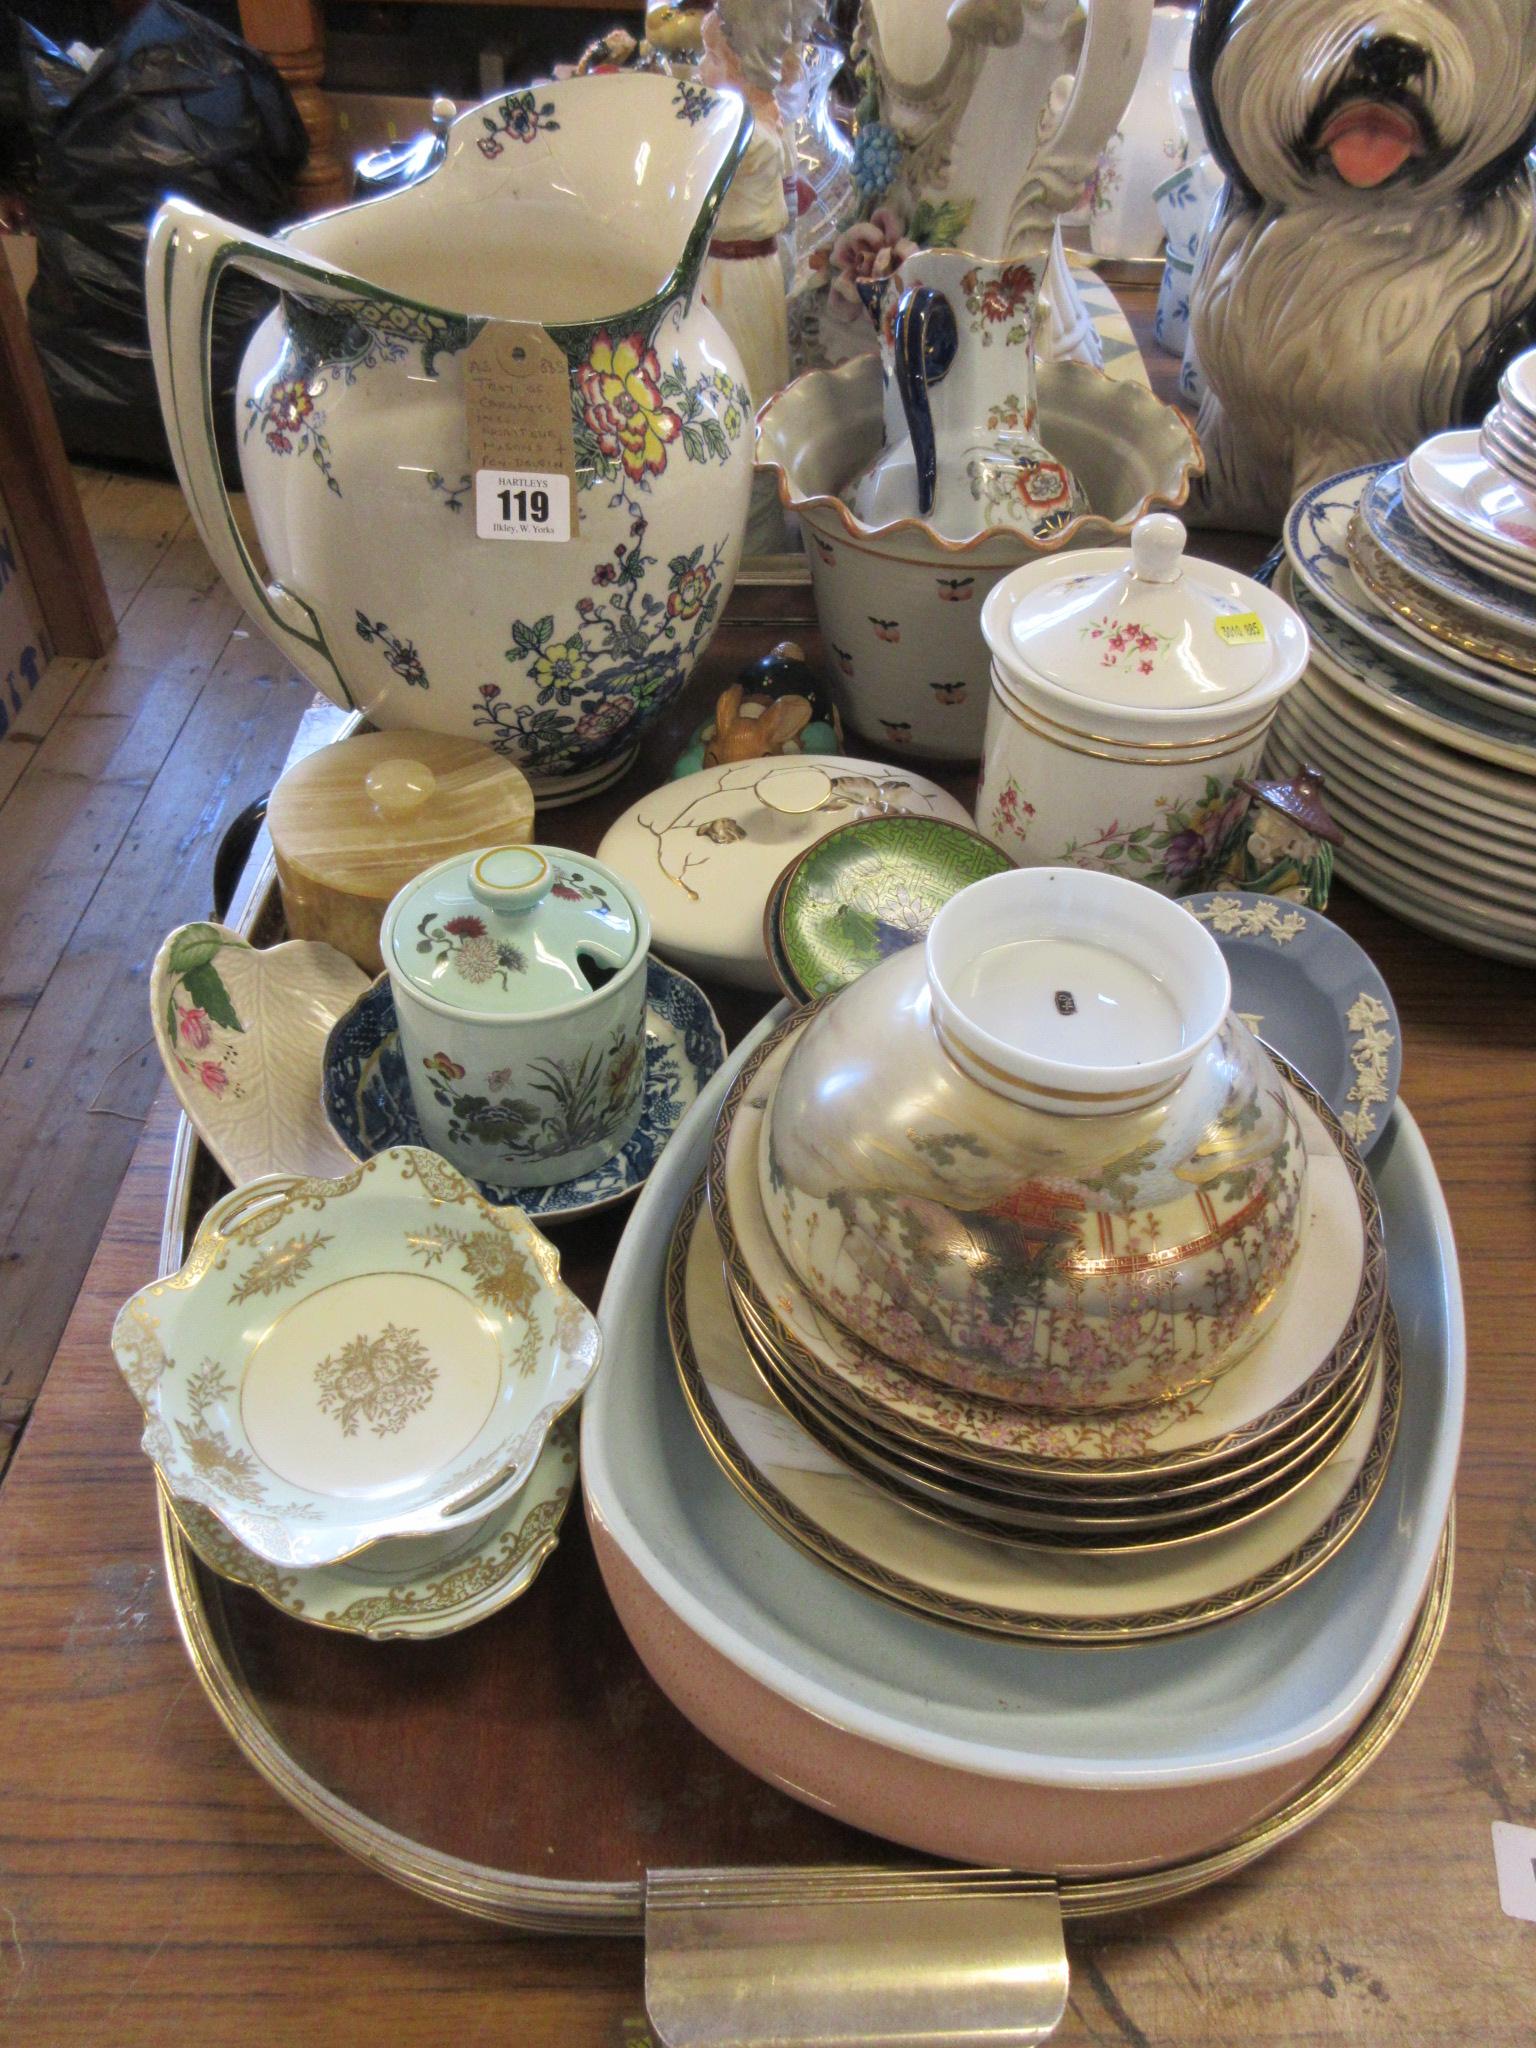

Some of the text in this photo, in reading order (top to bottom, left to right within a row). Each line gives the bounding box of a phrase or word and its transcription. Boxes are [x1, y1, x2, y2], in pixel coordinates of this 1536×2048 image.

[498, 477, 548, 488] HARTLEYS
[497, 489, 549, 523] 119
[493, 523, 555, 535] Ilkley, W. Yorks
